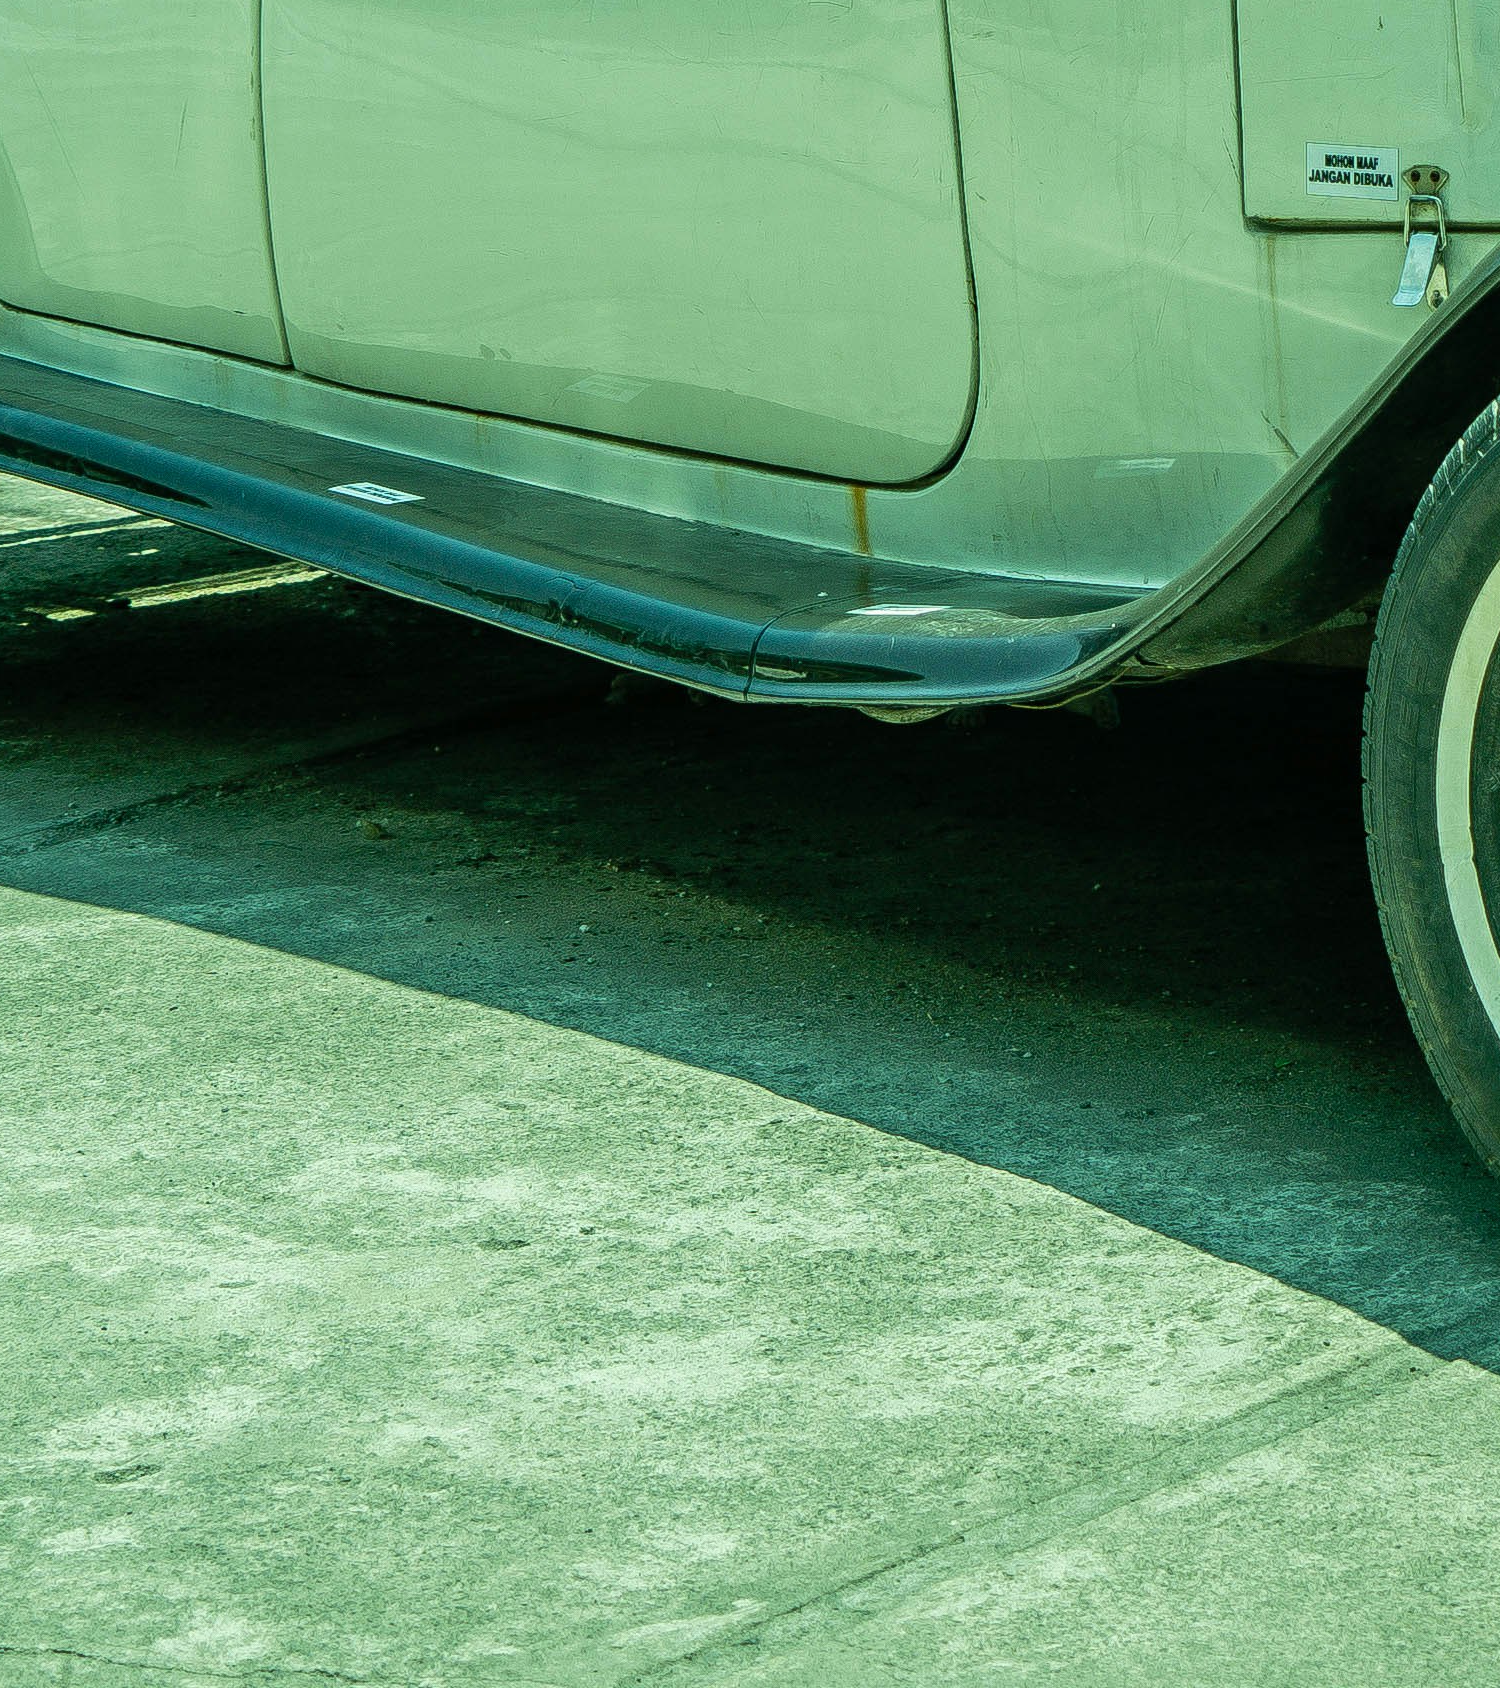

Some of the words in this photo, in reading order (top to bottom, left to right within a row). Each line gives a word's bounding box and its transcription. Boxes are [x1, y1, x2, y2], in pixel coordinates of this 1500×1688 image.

[1324, 154, 1354, 169] MOHON
[1356, 156, 1379, 171] MAAF
[1309, 169, 1351, 185] JANGAN
[1353, 172, 1393, 188] DIBUKA
